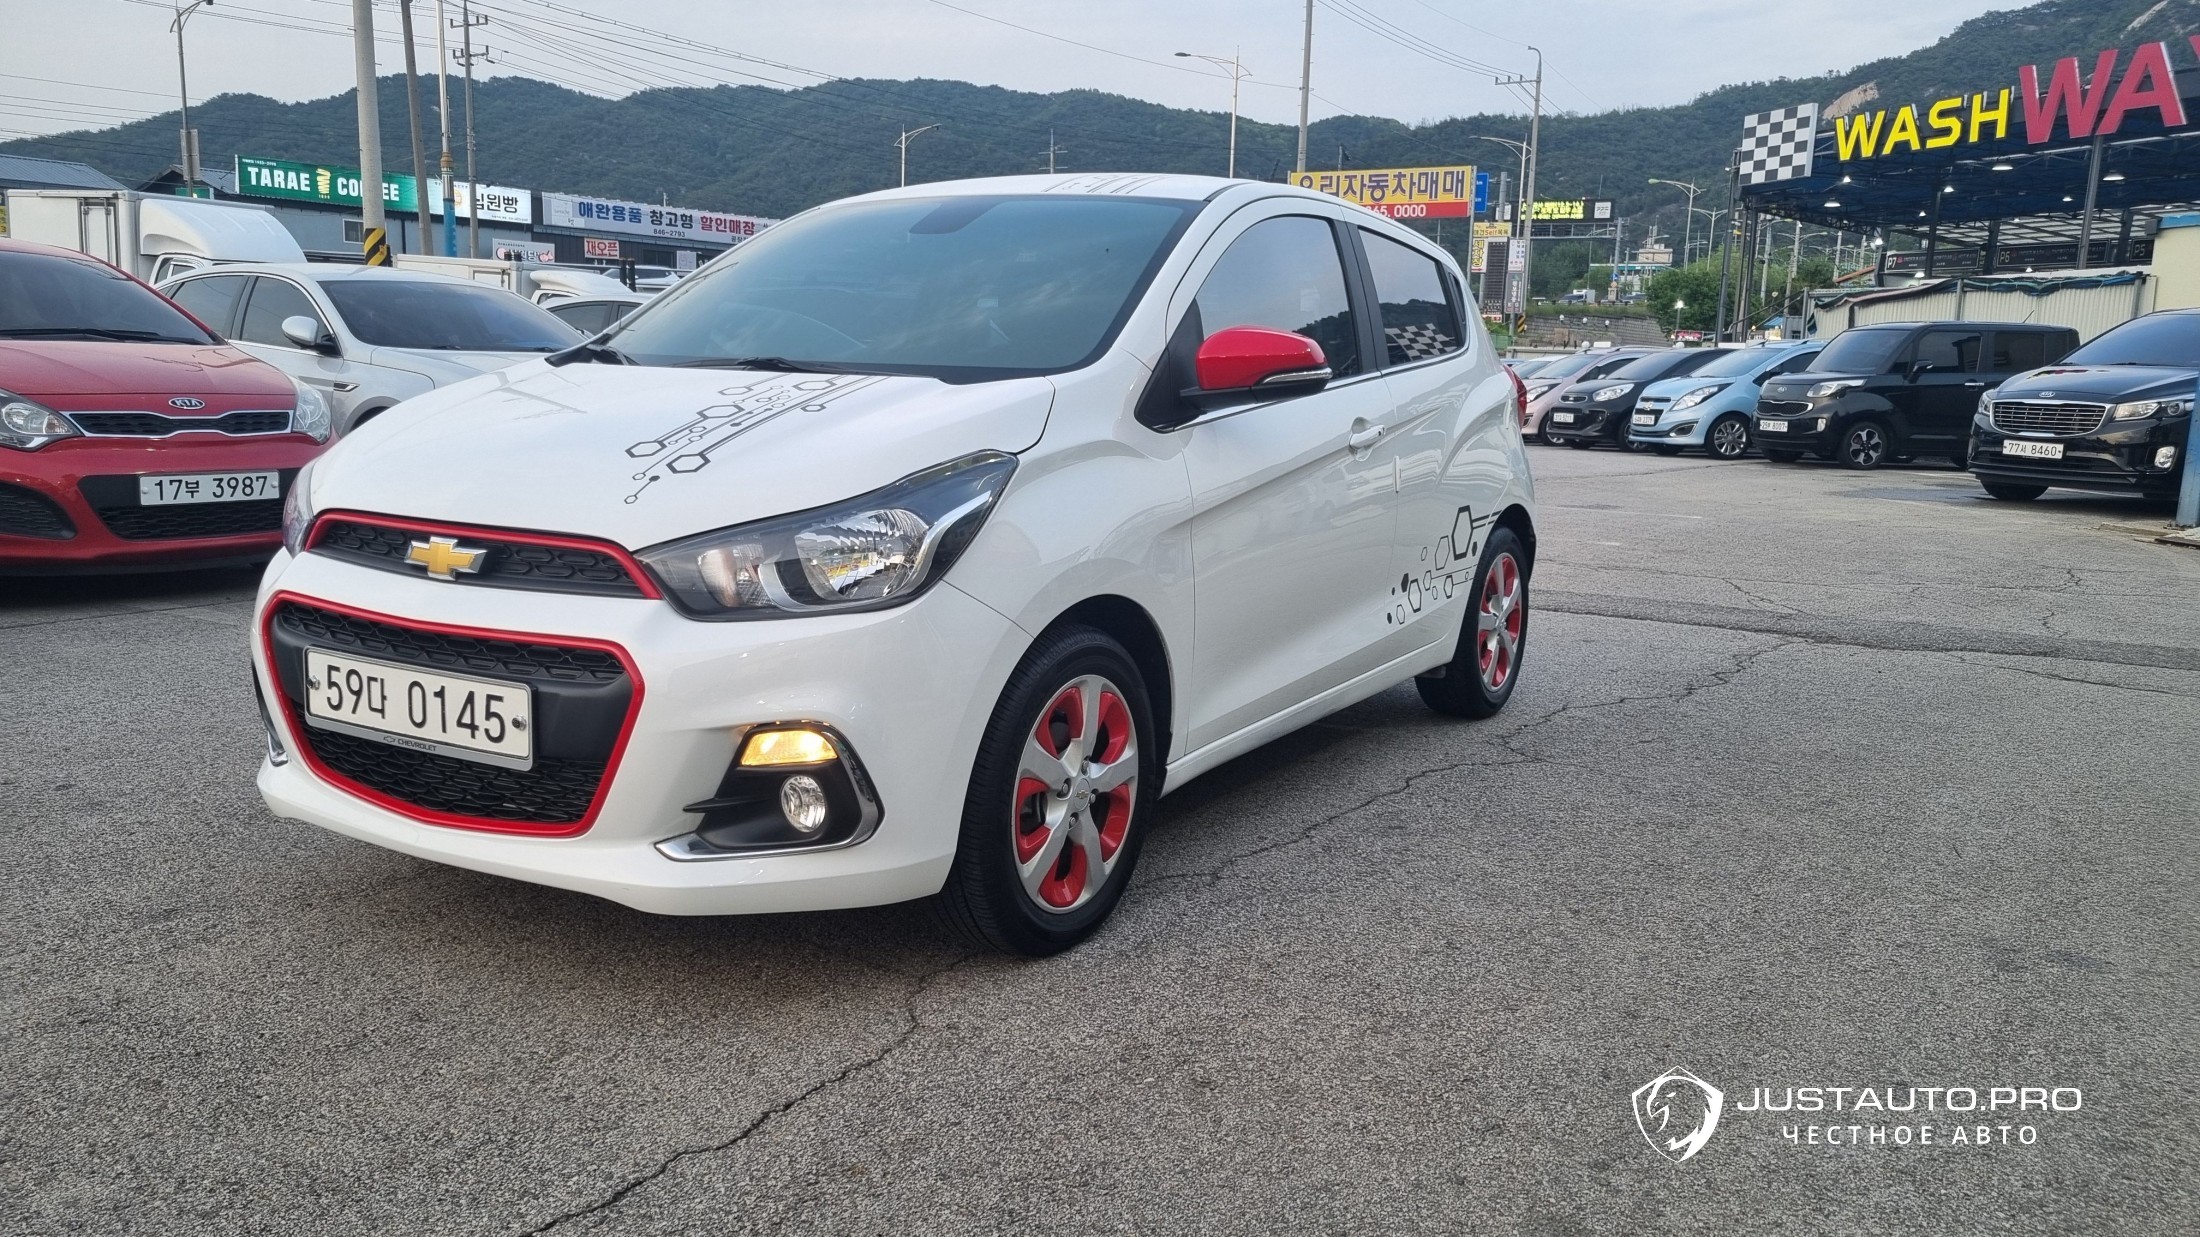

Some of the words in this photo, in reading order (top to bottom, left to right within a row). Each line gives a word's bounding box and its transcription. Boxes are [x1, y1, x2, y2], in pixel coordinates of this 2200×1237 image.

[1834, 88, 2011, 162] WASH
[2018, 34, 2200, 145] WA
[247, 166, 311, 192] TARAE
[336, 176, 399, 201] COEE
[578, 201, 642, 224] 애완용품
[649, 209, 694, 230] 창고형
[700, 215, 756, 236] 할인매장
[1366, 205, 1391, 218] 65.
[1393, 204, 1427, 218] 0000
[585, 240, 619, 257] 재오픈
[1999, 251, 2011, 263] P6
[1887, 256, 1898, 268] P7
[2030, 444, 2057, 457] 8460
[154, 479, 200, 501] 17부
[212, 475, 268, 499] 3987
[326, 663, 388, 720] 59다
[407, 680, 507, 744] 0145
[397, 737, 437, 752] CHEVROLET
